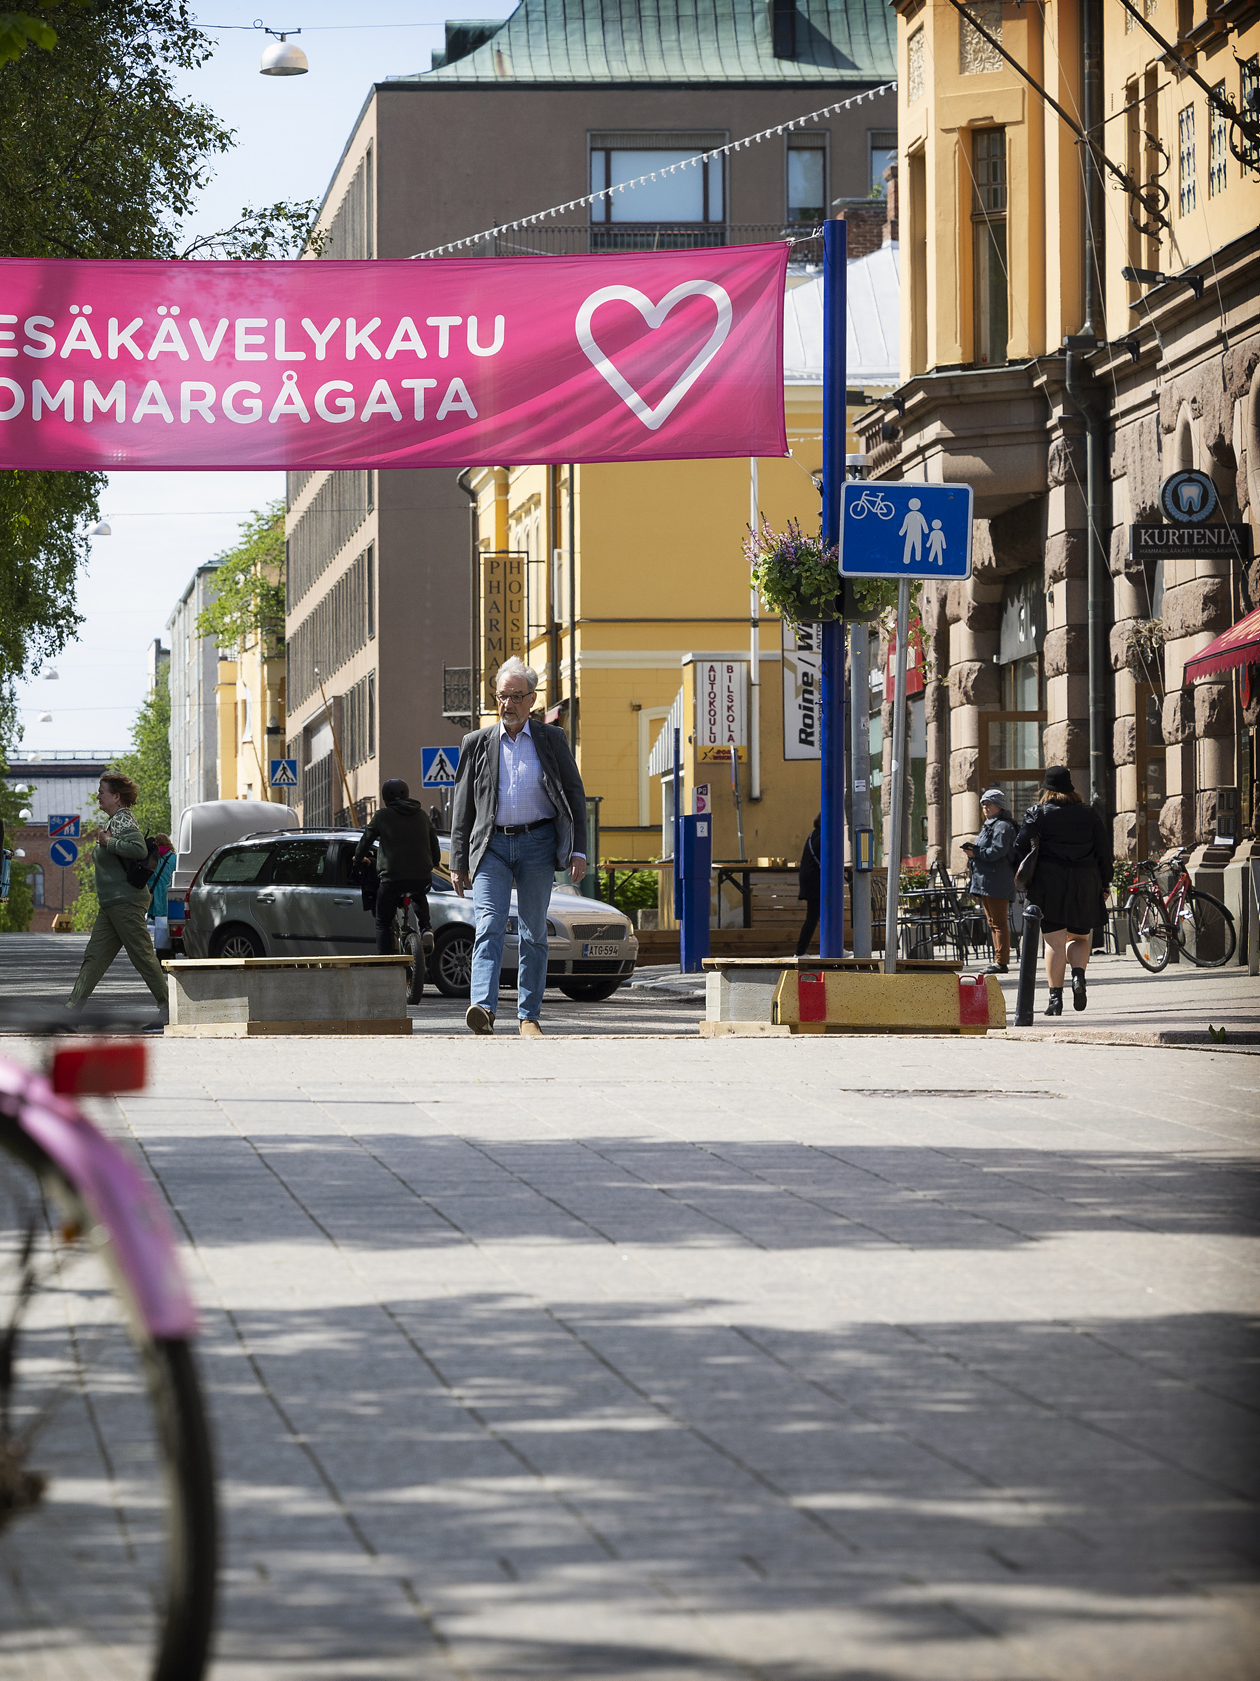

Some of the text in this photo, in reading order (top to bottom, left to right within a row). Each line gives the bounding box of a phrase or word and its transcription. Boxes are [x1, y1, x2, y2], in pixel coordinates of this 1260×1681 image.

[1140, 528, 1241, 546] KURTENIA
[508, 560, 522, 651] HOUSE
[708, 664, 717, 744] AUTOKOULU
[726, 664, 735, 743] BILSKOLA
[798, 671, 815, 747] Roine
[699, 825, 705, 833] 2
[589, 945, 618, 956] ATG-594
